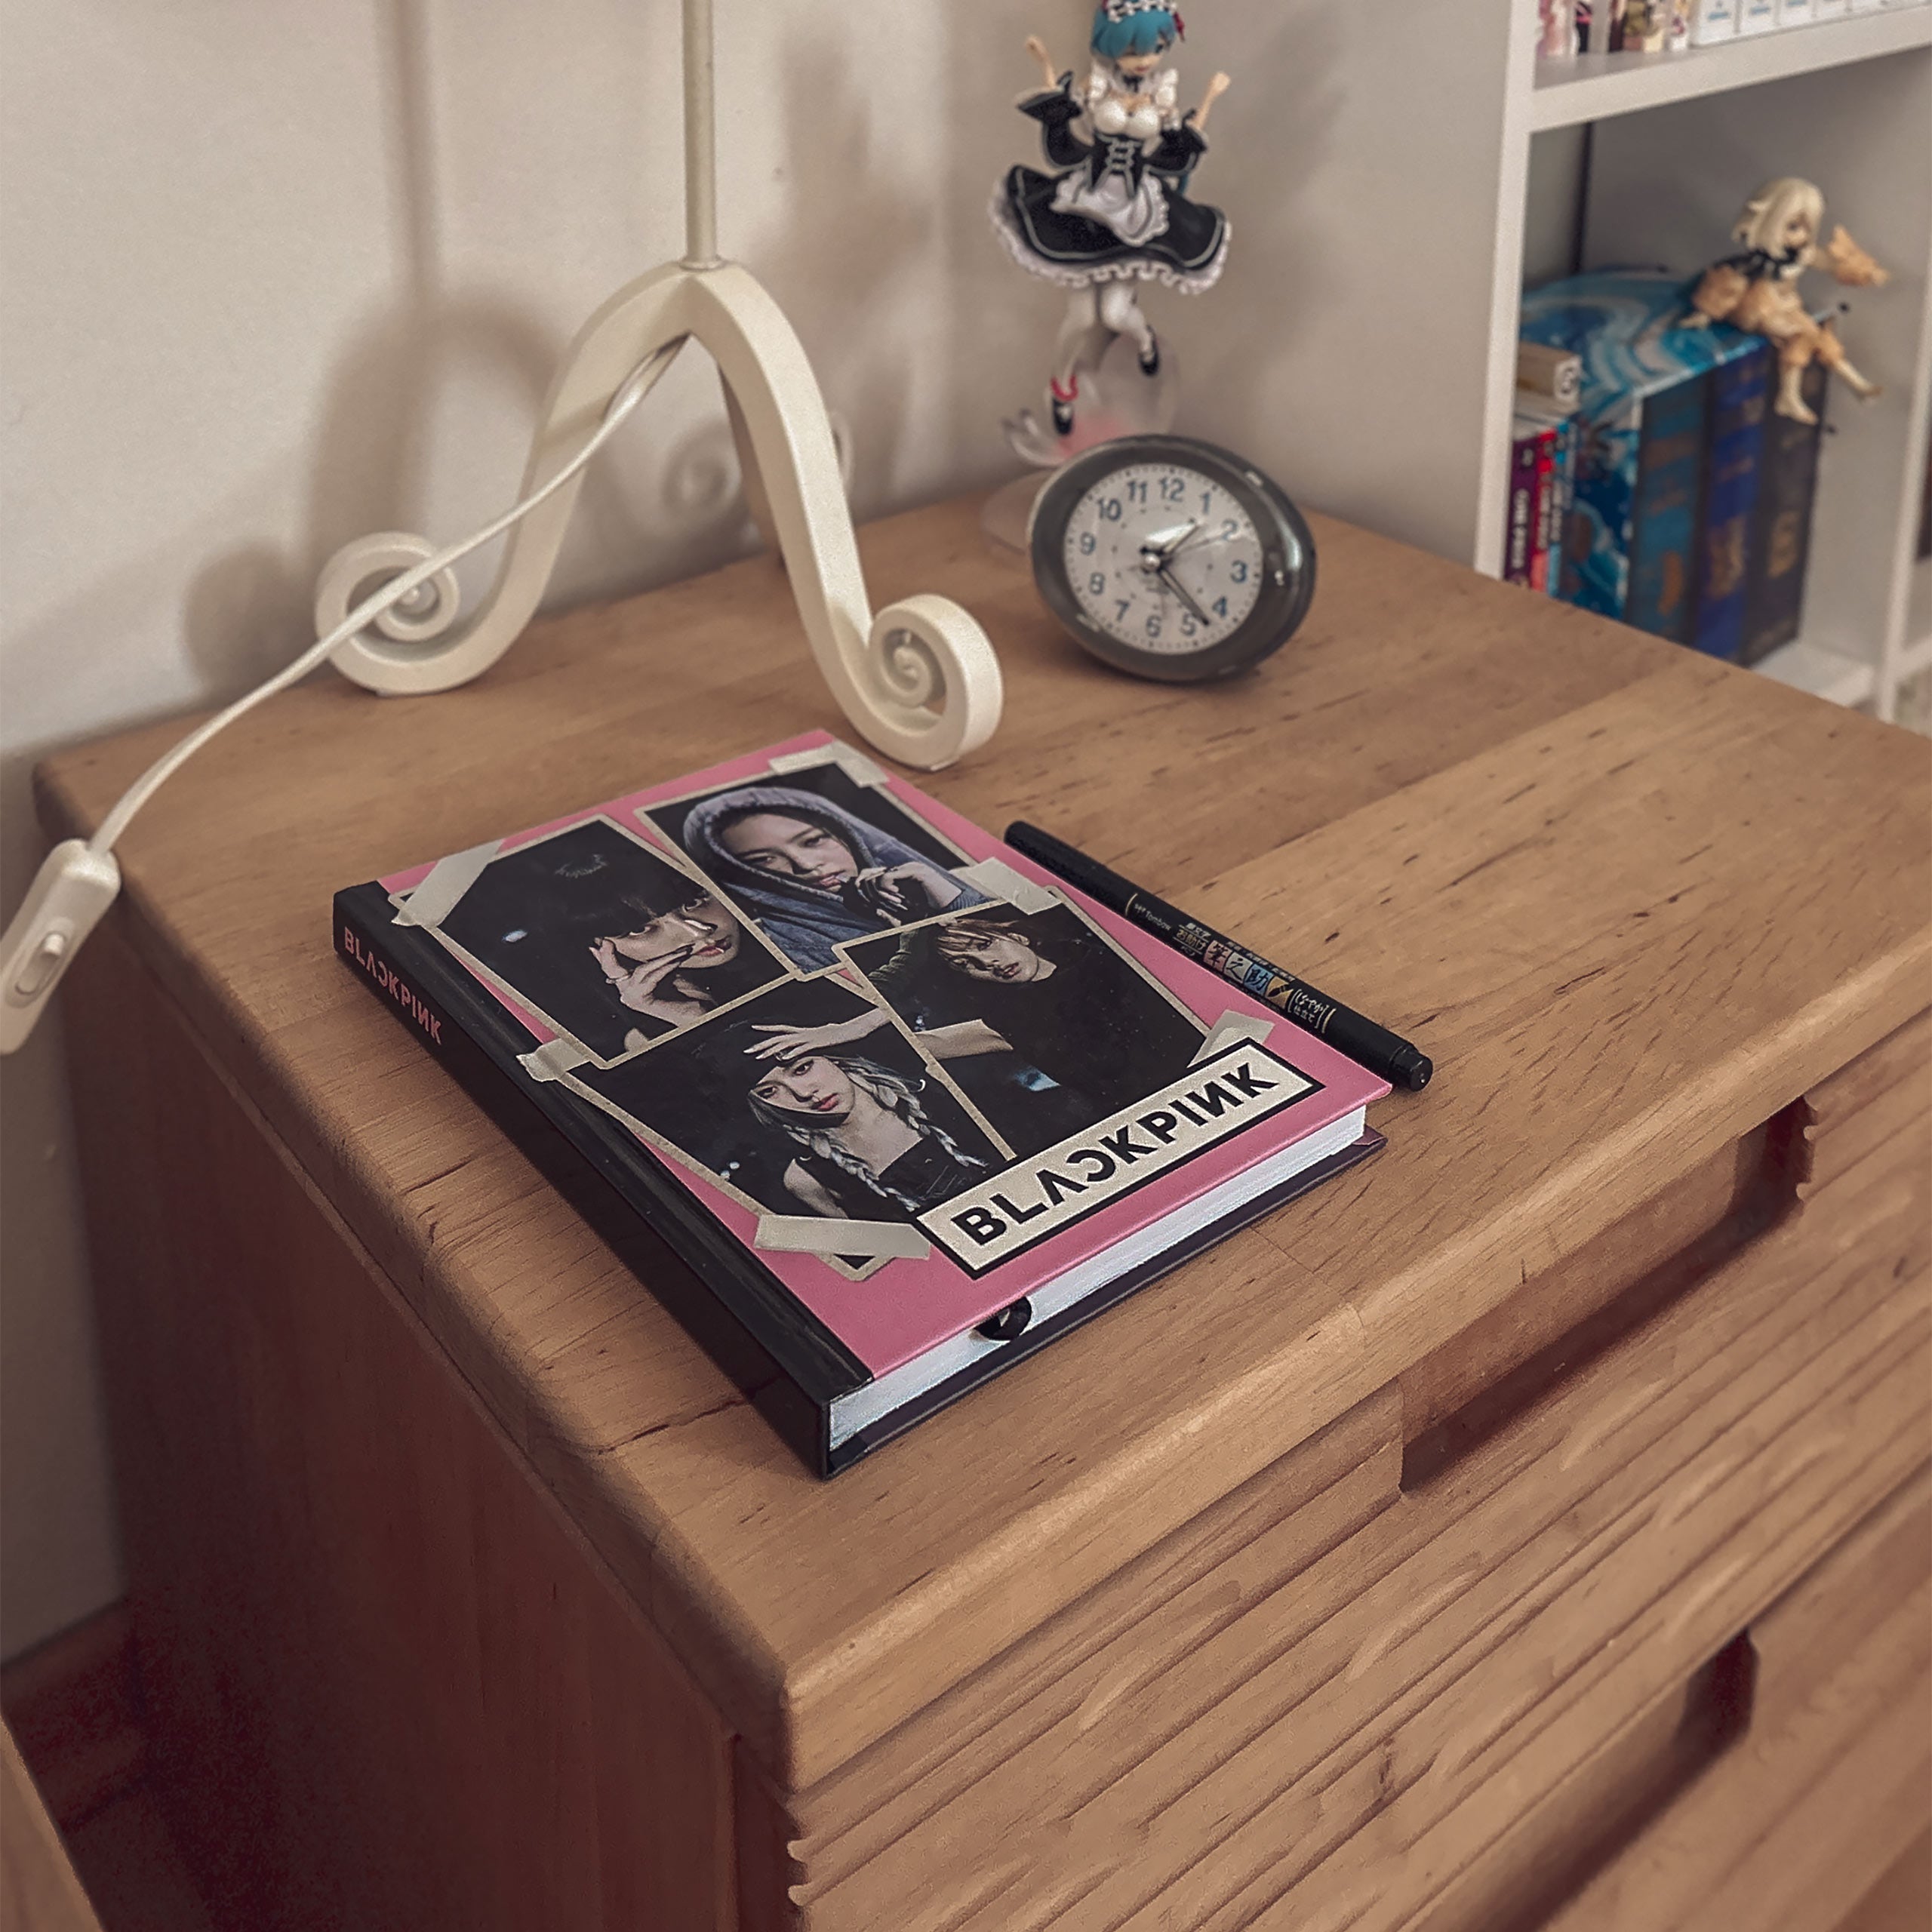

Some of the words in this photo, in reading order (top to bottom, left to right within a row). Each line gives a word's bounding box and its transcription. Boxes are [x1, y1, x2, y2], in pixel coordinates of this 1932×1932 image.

[1128, 480, 1149, 504] 11
[1158, 477, 1185, 503] 12
[1097, 498, 1122, 521] 10
[1200, 492, 1211, 515] 1
[1221, 519, 1238, 542] 2
[1079, 532, 1097, 555] 9
[1230, 560, 1247, 583] 3
[1089, 572, 1106, 595] 8
[1115, 599, 1131, 622] 7
[1211, 595, 1229, 618] 4
[1146, 615, 1162, 638] 6
[1180, 613, 1197, 637] 5
[951, 1062, 1279, 1246] BLACKPINK
